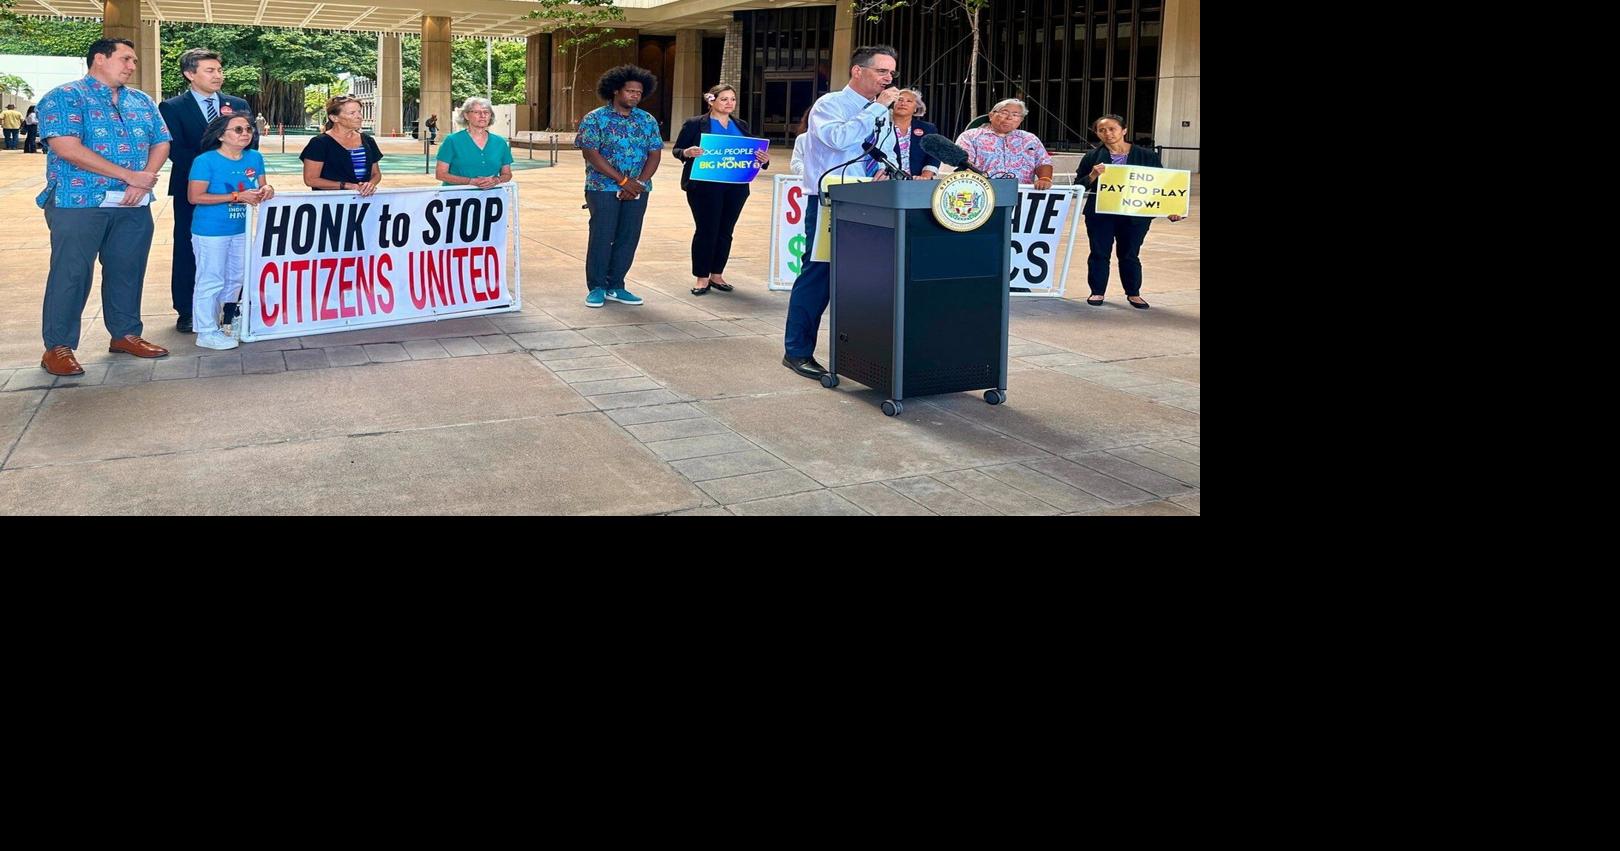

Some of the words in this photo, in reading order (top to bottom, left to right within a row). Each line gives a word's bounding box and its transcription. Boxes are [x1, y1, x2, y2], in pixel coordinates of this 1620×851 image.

[724, 147, 754, 155] PEOPLE
[699, 160, 716, 169] BIG
[716, 160, 753, 169] MONEY
[939, 175, 958, 191] STATE
[971, 174, 990, 191] HAWAII
[1129, 172, 1154, 182] END
[1100, 183, 1125, 193] PAY
[1129, 185, 1148, 195] TO
[1152, 188, 1188, 197] PLAY
[1121, 198, 1160, 208] NOW!
[261, 203, 371, 258] HONK
[378, 204, 411, 249] to
[422, 197, 503, 246] STOP
[259, 253, 395, 328] CITIZENS
[408, 246, 500, 310] UNITED
